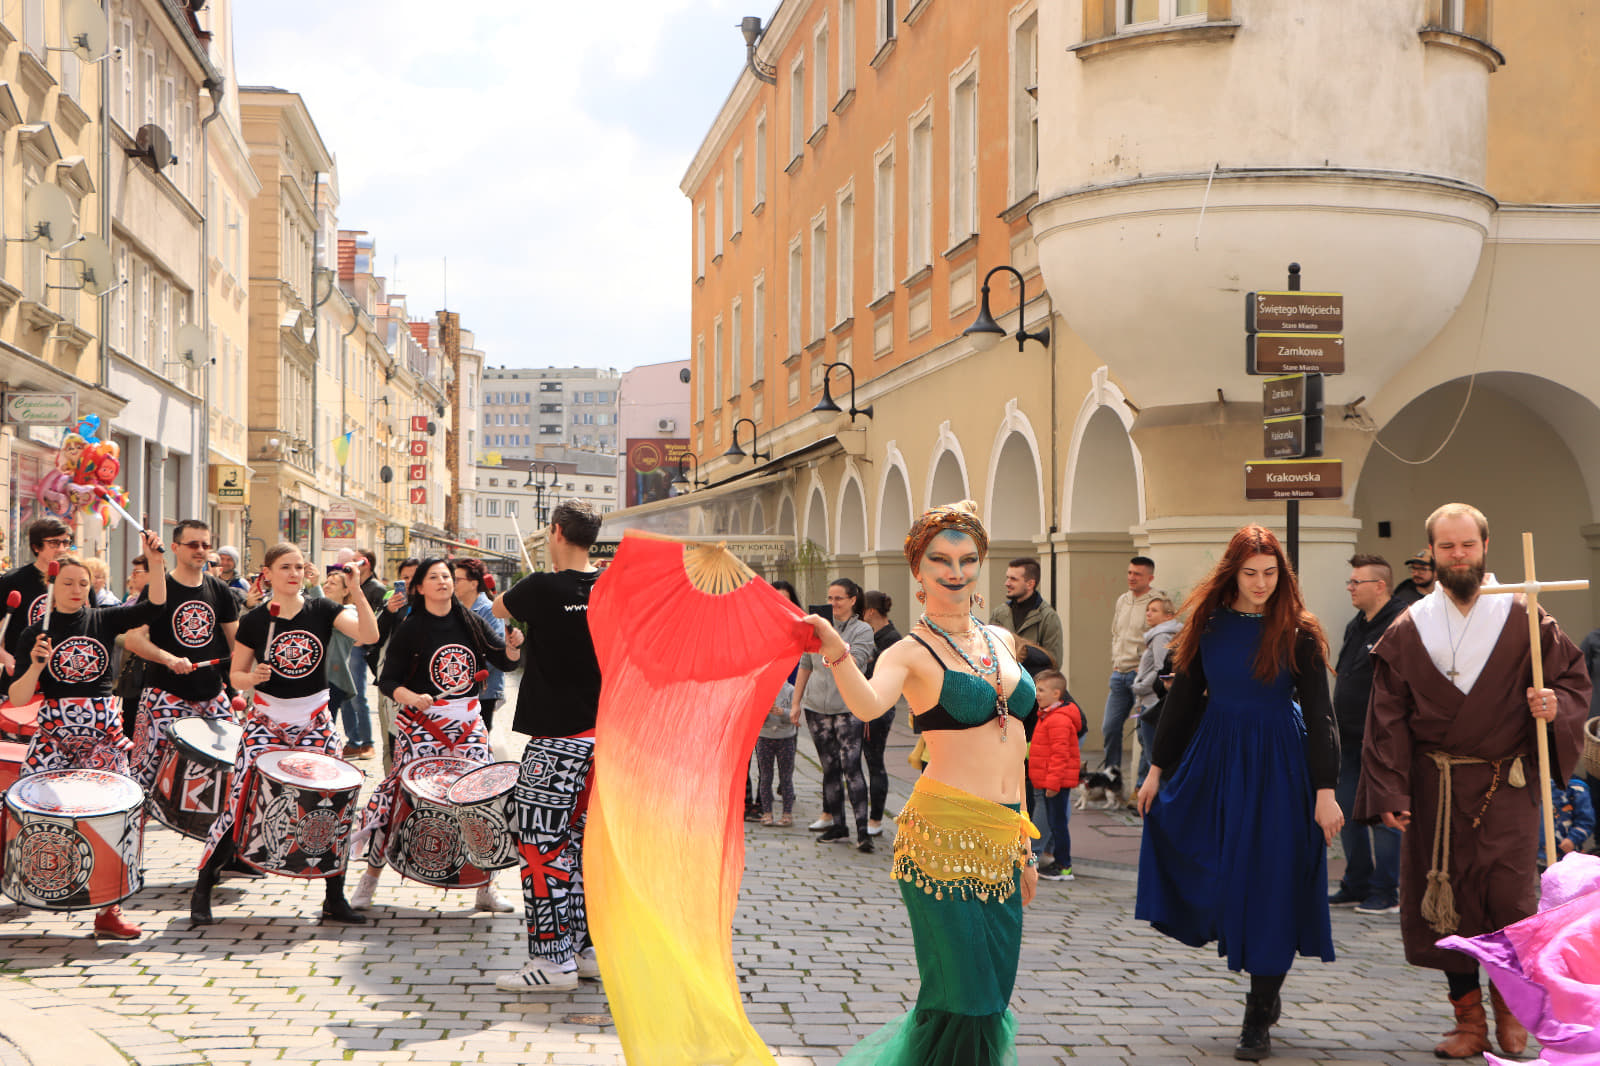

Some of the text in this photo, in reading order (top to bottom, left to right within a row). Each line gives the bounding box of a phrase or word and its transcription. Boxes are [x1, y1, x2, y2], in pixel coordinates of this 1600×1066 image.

[1259, 302, 1341, 316] Świętego Wojciecha
[1277, 346, 1324, 356] Zamkowa
[1282, 363, 1298, 371] Stare
[1265, 471, 1321, 482] Krakowska
[25, 823, 76, 840] BATALA
[411, 863, 447, 878] MUNDO
[27, 884, 69, 898] MUNDO
